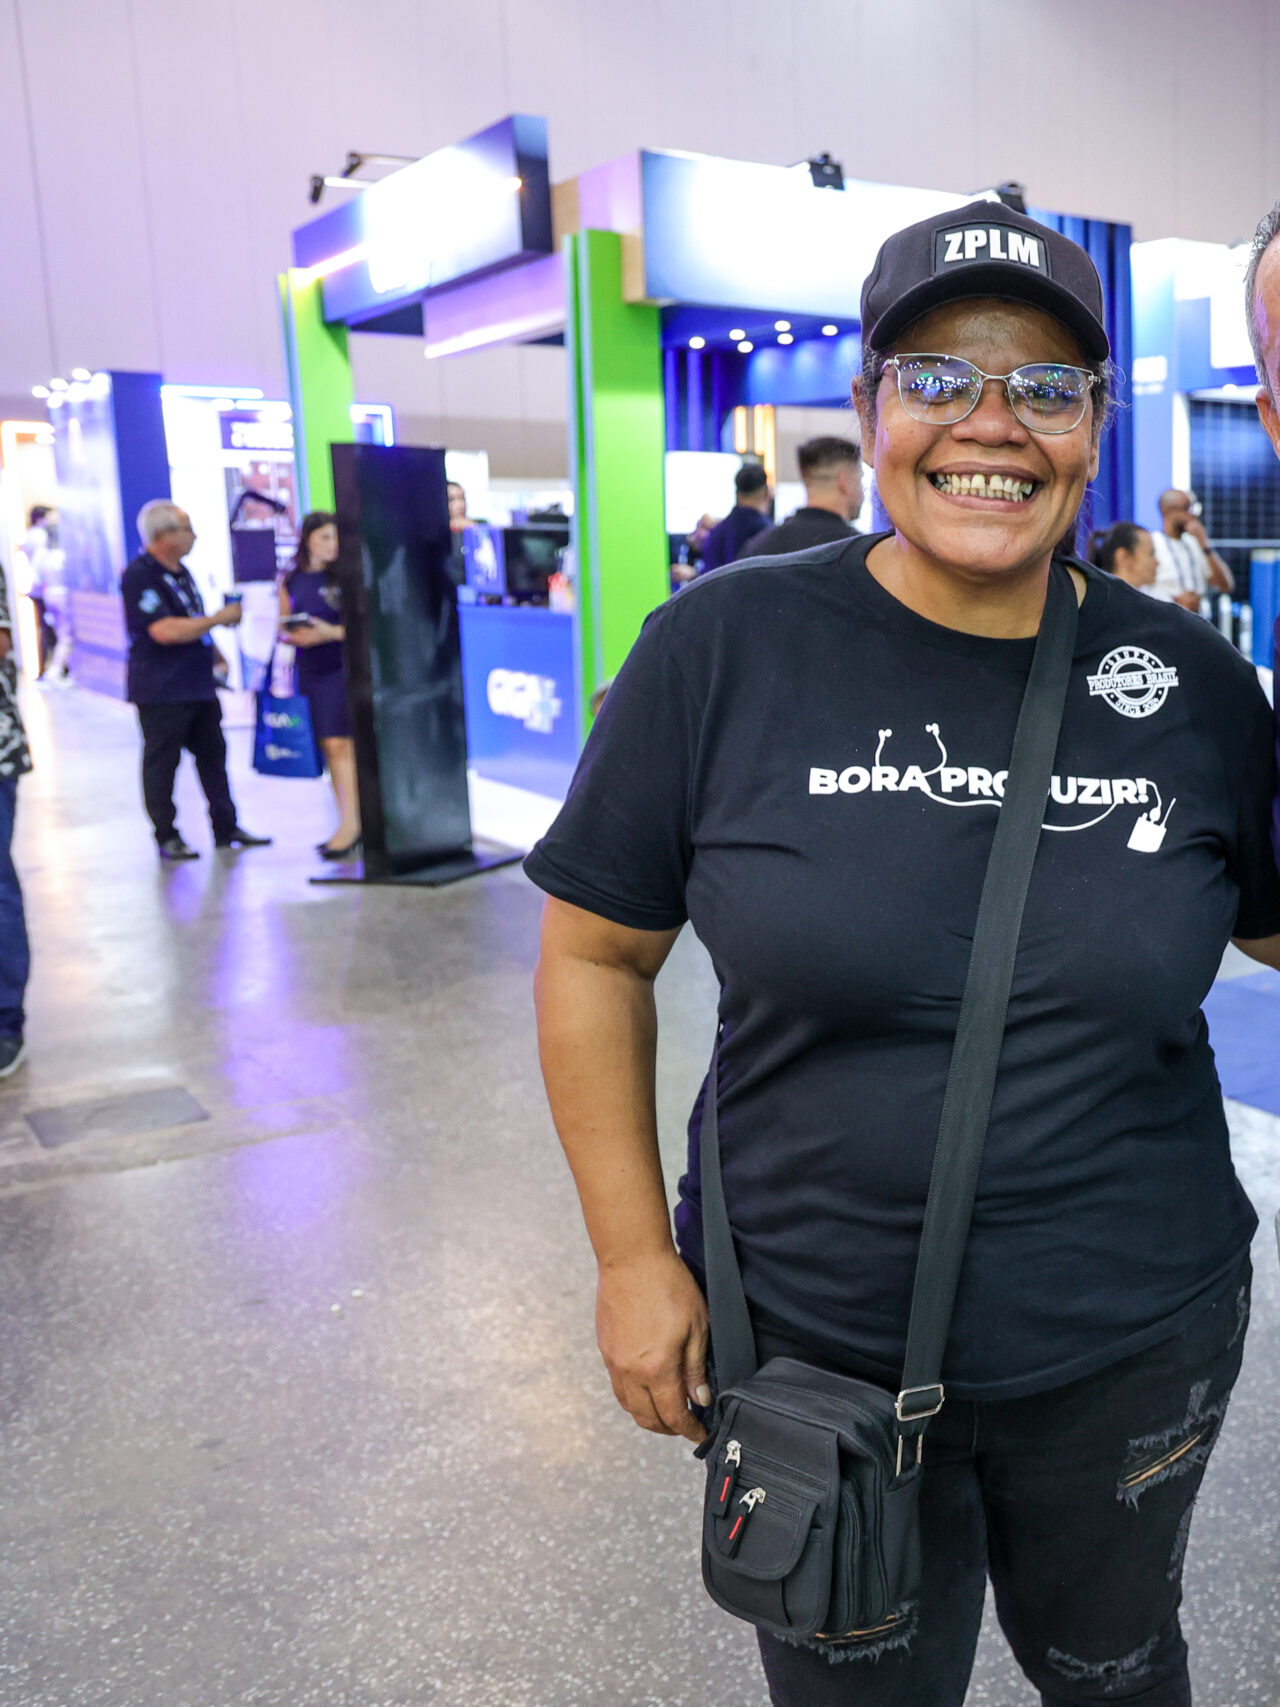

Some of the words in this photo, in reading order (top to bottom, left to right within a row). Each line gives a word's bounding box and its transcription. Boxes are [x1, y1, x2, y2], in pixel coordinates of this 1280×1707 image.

[944, 228, 1040, 268] ZPLM
[1088, 675, 1144, 691] PRODUTORES
[1146, 672, 1178, 685] BRASIL
[809, 765, 931, 795] BORA
[941, 767, 1149, 805] PRUZIR!
